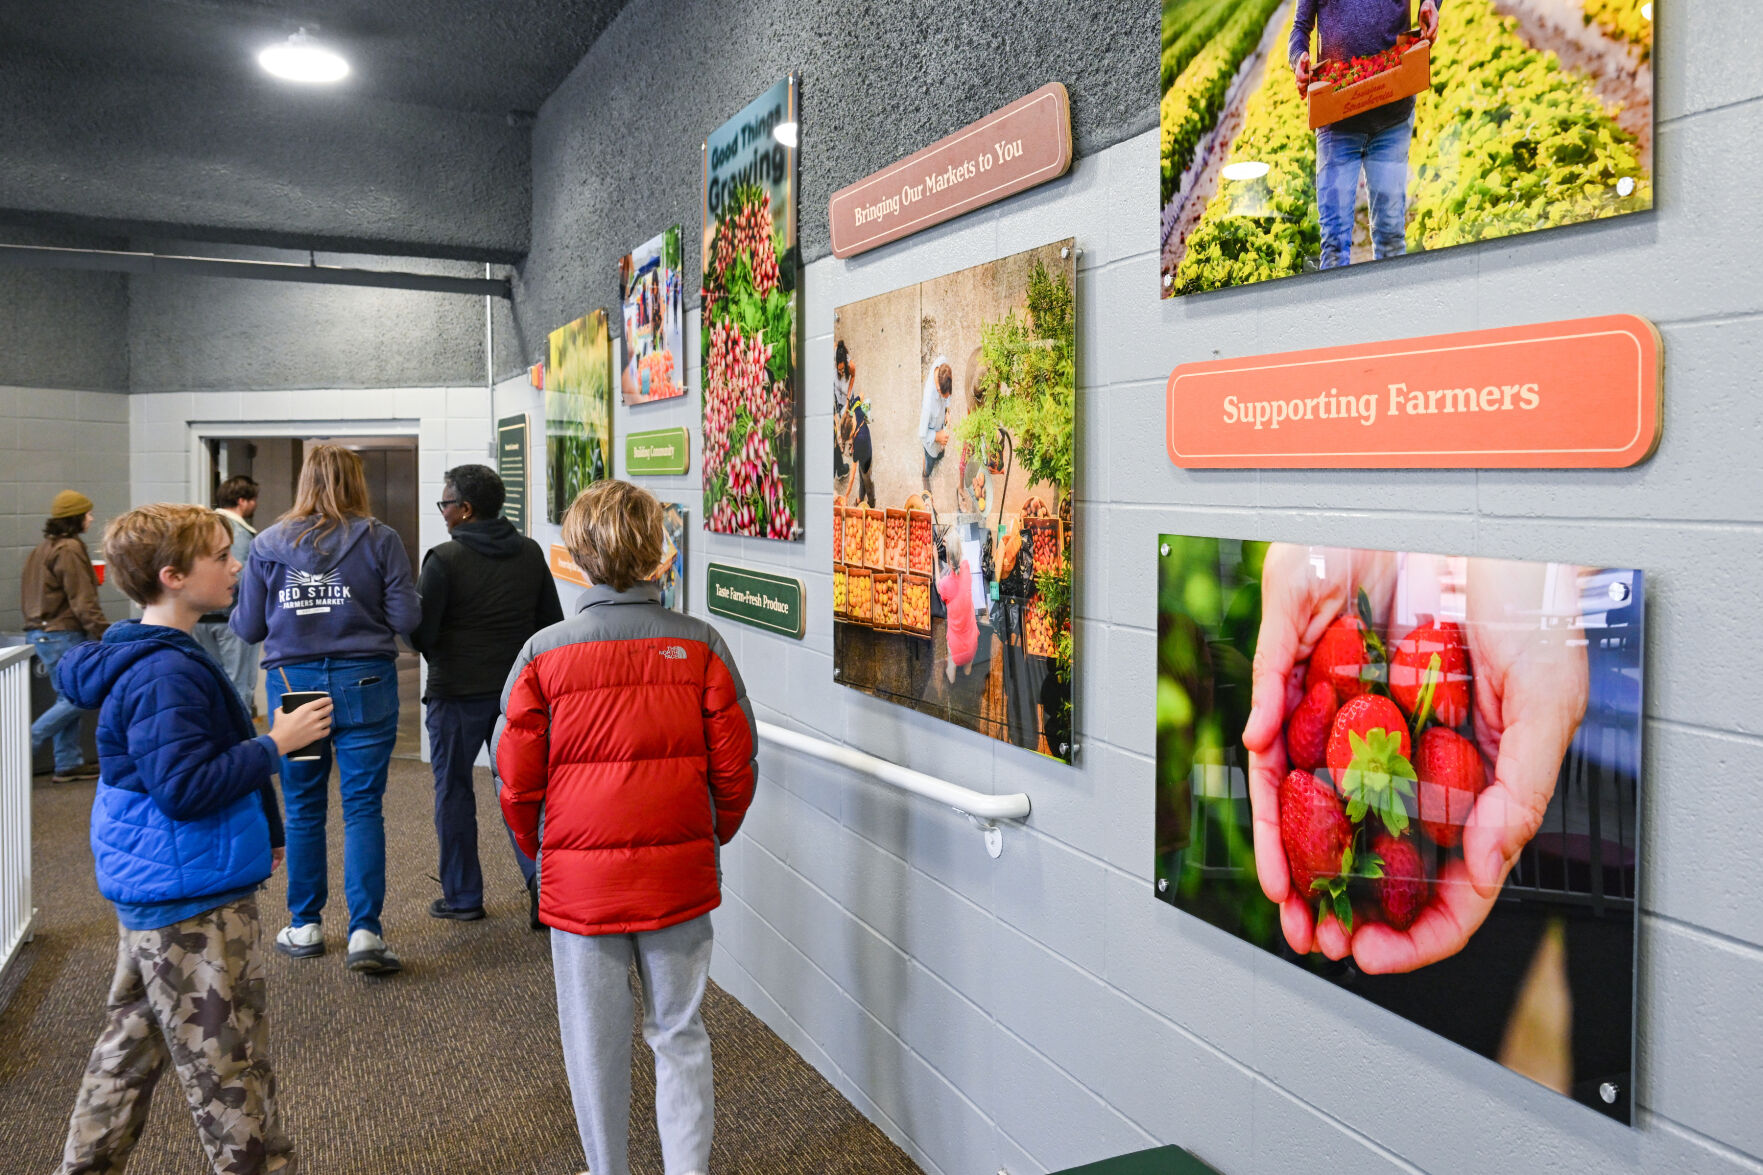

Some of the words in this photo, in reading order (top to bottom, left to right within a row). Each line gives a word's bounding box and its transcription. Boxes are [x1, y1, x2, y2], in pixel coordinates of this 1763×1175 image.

[711, 132, 738, 171] Good
[741, 103, 781, 150] Things
[854, 194, 900, 226] Bringing
[901, 184, 924, 206] Our
[925, 160, 976, 196] Markets
[978, 153, 993, 172] to
[994, 138, 1024, 165] You
[1222, 388, 1378, 430] Supporting
[1387, 382, 1540, 416] Farmers
[278, 587, 301, 603] RED
[307, 586, 351, 599] STICK
[716, 583, 729, 599] Taste
[729, 586, 762, 608] Farm-Fresh
[762, 594, 789, 615] Produce
